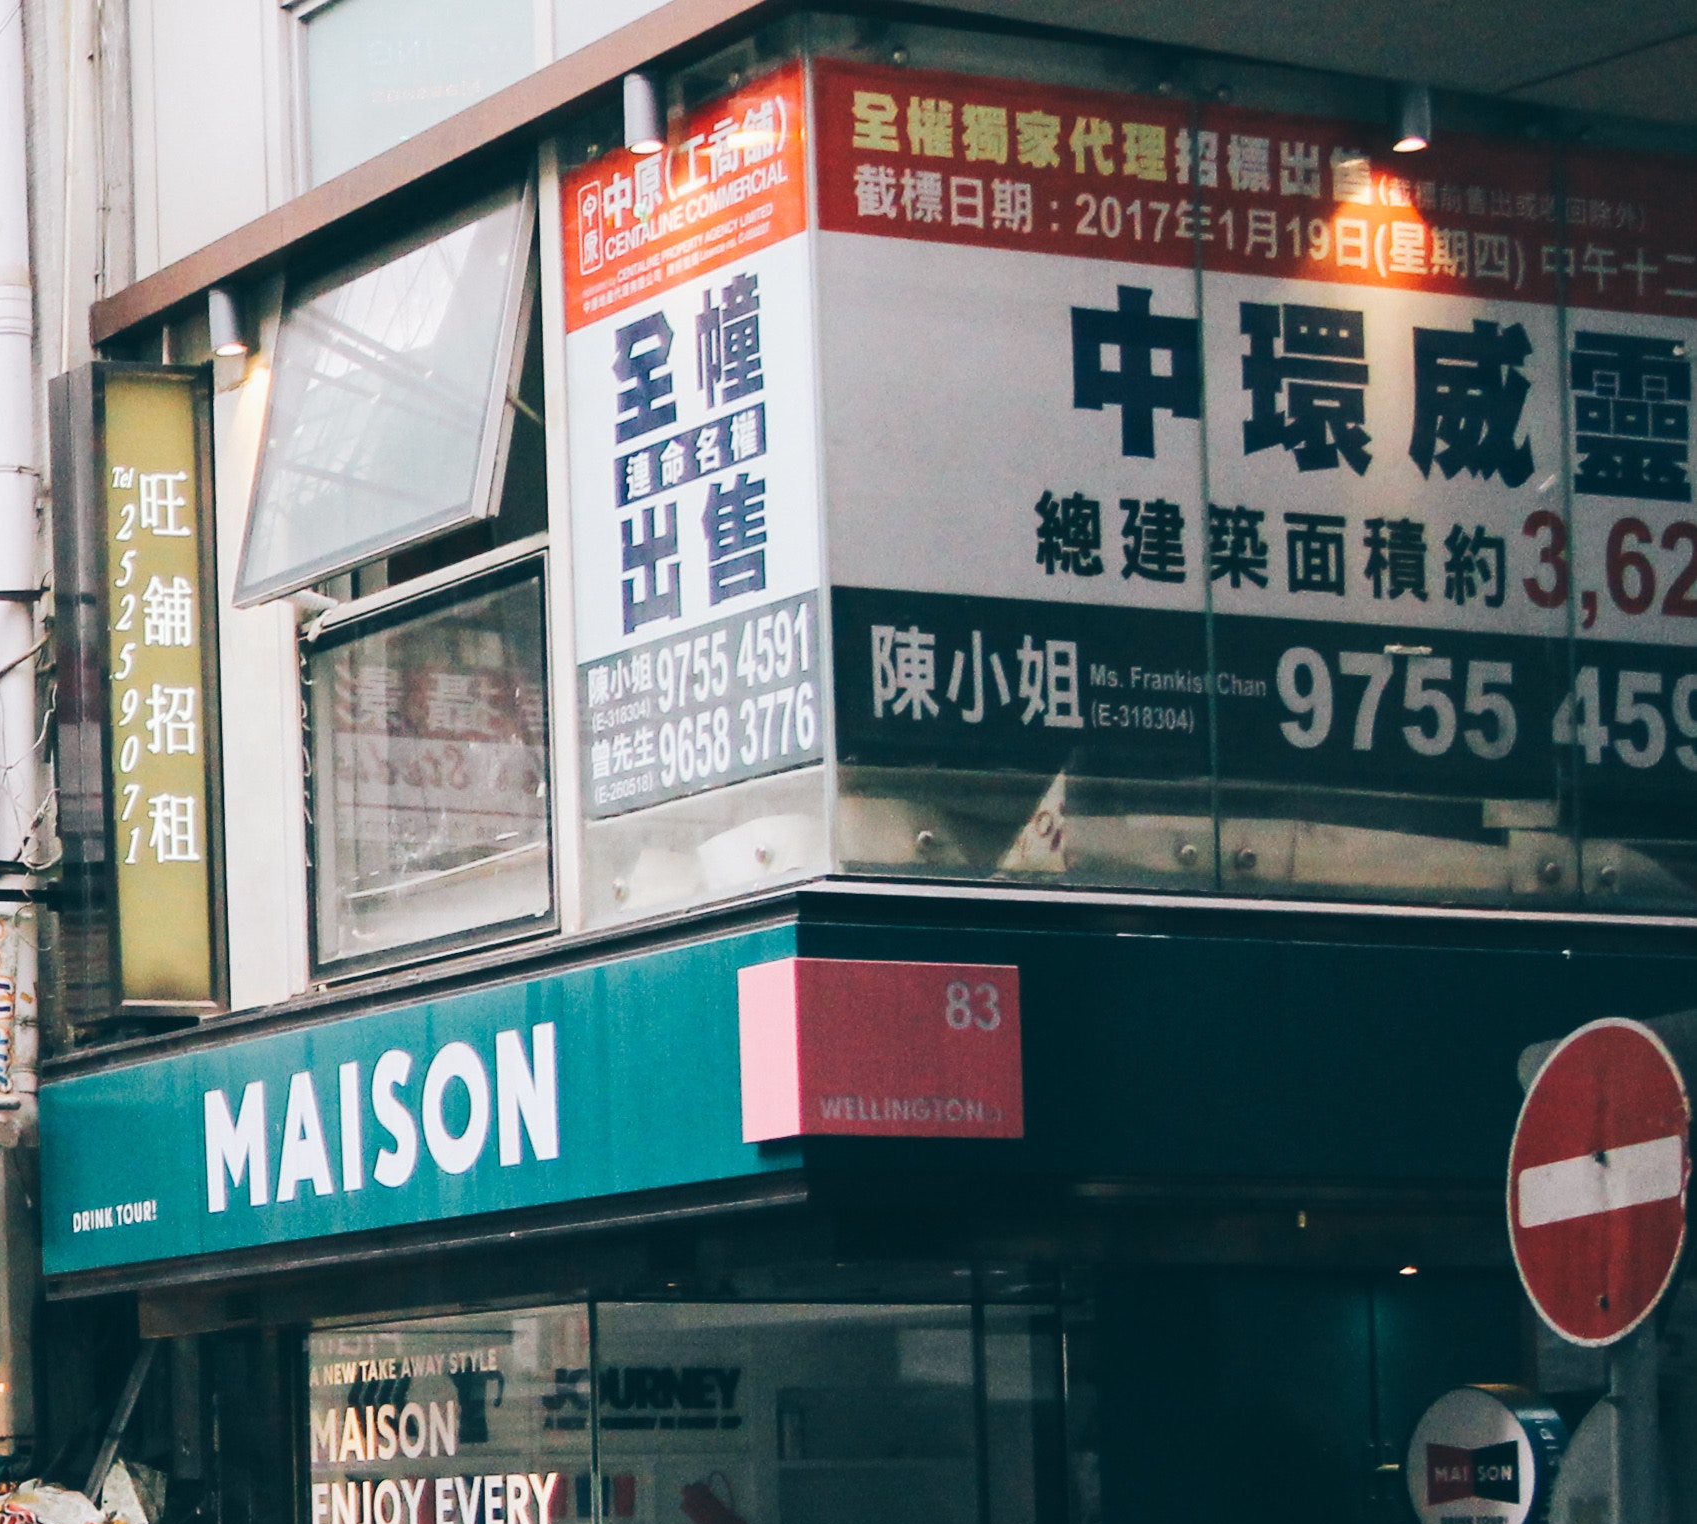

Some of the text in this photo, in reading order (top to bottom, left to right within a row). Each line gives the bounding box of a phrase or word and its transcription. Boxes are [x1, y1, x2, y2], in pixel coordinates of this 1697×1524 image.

[111, 466, 134, 490] Tel
[656, 629, 728, 714] 9755
[736, 601, 810, 687] 4591
[870, 624, 1518, 760] 陳小姐 Ms. Chan 9755
[658, 705, 731, 789] 9658
[739, 680, 815, 766] 3776
[944, 980, 1001, 1032] 83
[203, 1021, 559, 1214] MAISON
[819, 1094, 985, 1124] WELLINGTON
[71, 1199, 157, 1234] DRINK TOUR!
[323, 1348, 498, 1385] NEW TAKE AWAY STYLE
[309, 1400, 458, 1465] MAISON
